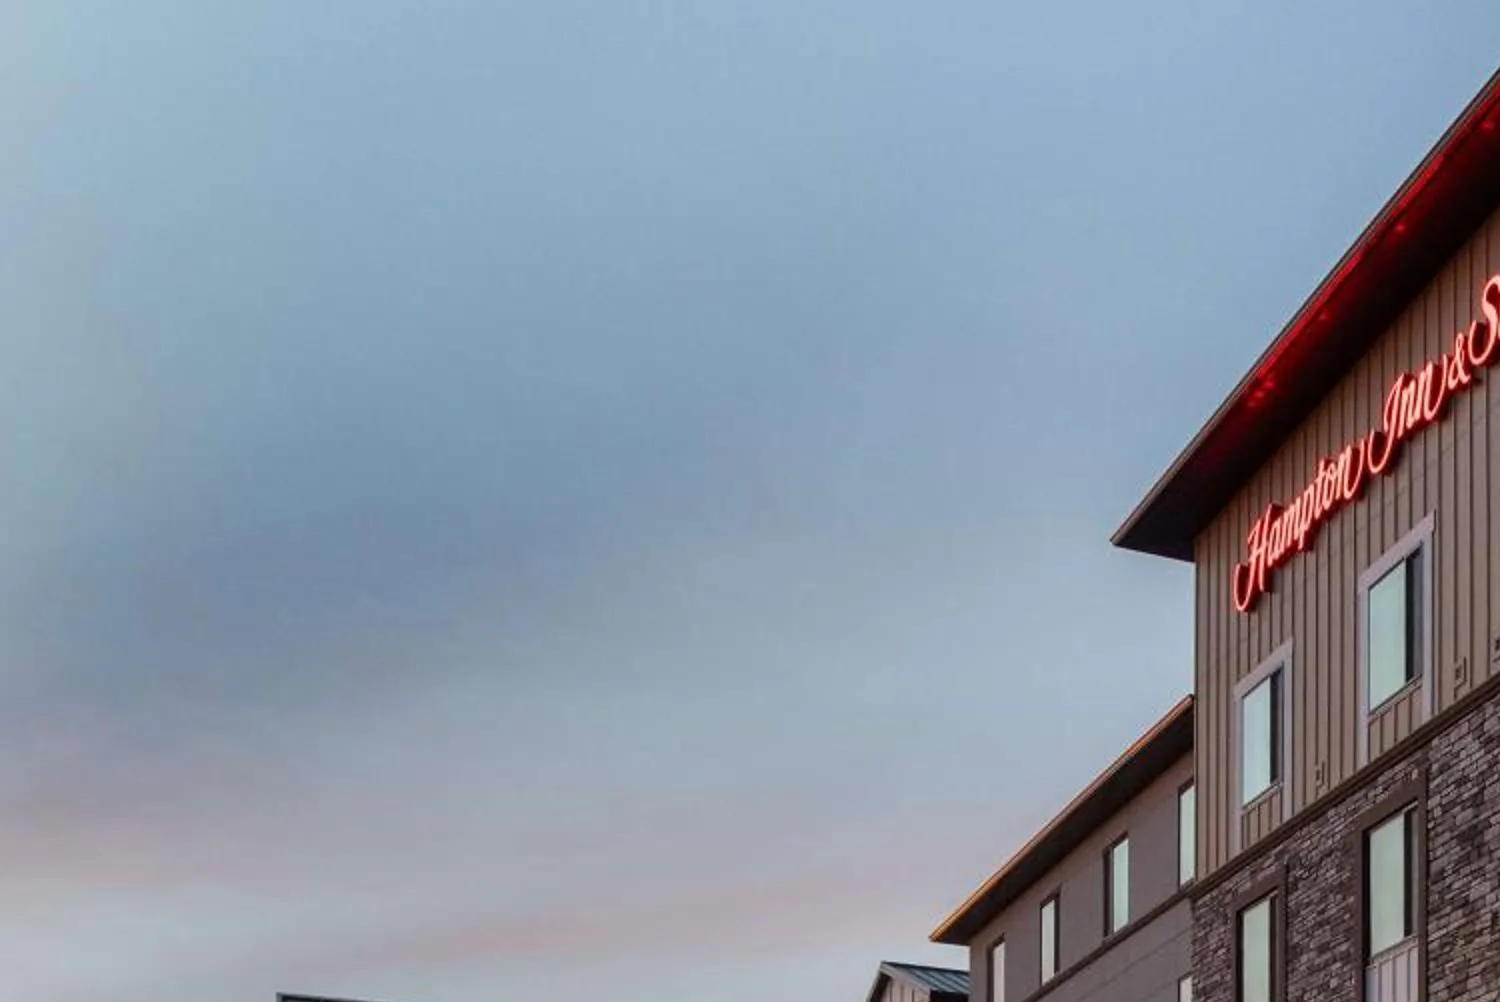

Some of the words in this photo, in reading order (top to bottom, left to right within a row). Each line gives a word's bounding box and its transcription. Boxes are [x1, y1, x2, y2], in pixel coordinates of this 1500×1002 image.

[1233, 438, 1366, 613] Hampton
[1367, 354, 1448, 474] Inn
[1448, 333, 1471, 390] &
